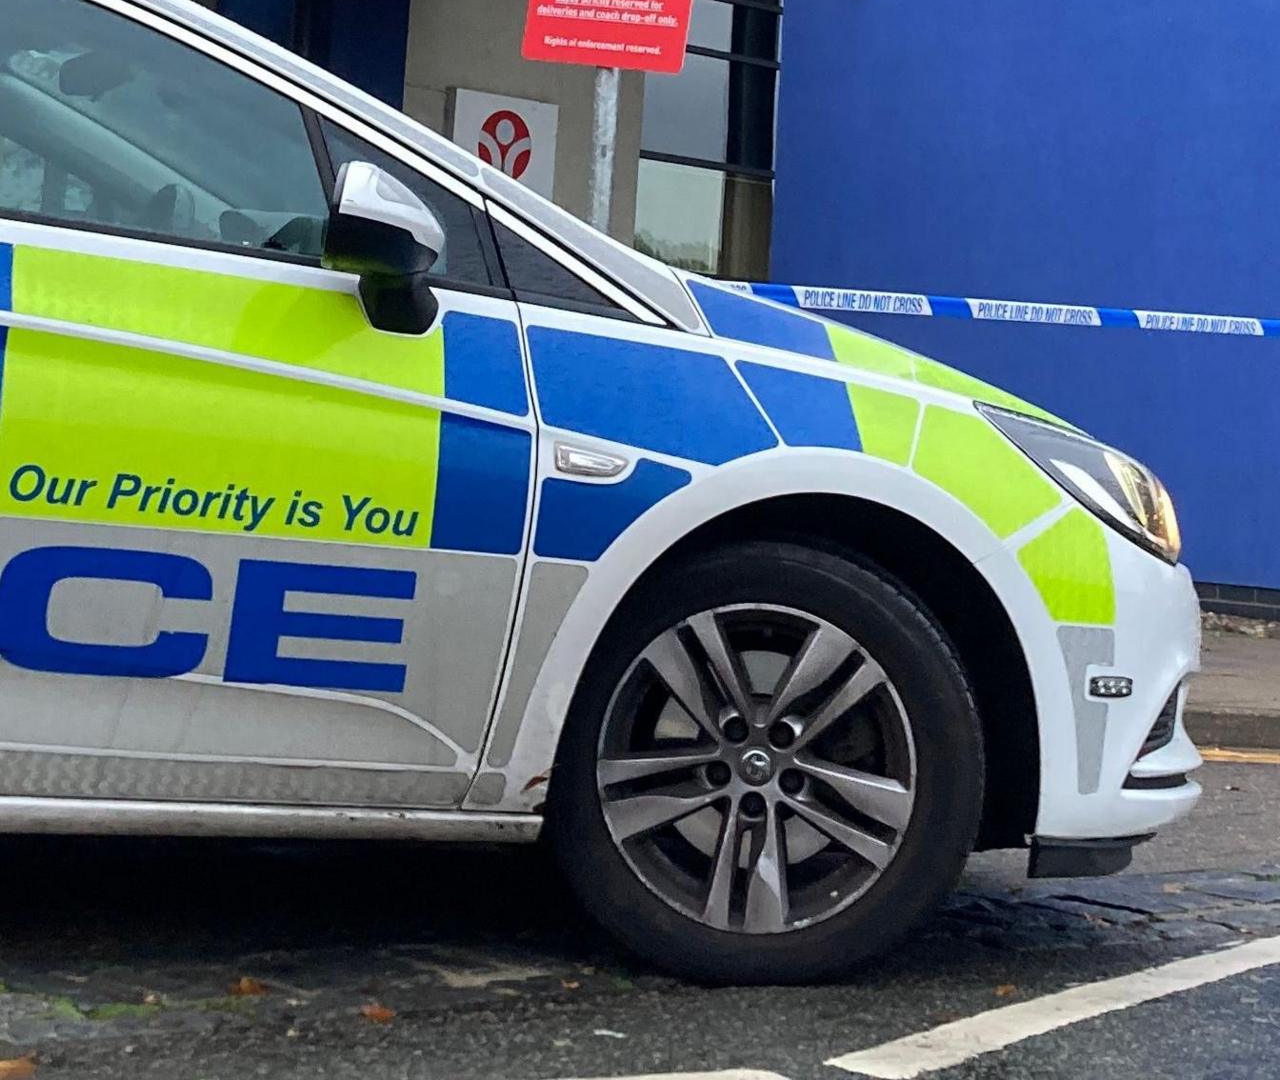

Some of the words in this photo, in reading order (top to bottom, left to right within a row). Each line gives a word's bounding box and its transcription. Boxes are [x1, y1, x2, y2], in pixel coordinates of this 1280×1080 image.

[537, 4, 578, 18] deliveries
[579, 8, 595, 19] and
[596, 9, 620, 21] coach
[621, 11, 657, 24] drop-off
[650, 0, 664, 10] for
[544, 35, 568, 48] Rights
[568, 38, 576, 47] of
[577, 39, 625, 51] enforcement
[626, 43, 661, 56] reserved.
[804, 289, 835, 307] POLICE
[837, 291, 857, 309] LINE
[858, 293, 872, 310] DO
[873, 294, 892, 311] NOT
[893, 295, 924, 313] CROSS
[977, 302, 1008, 319] POLICE
[1009, 304, 1029, 321] LINE
[1030, 305, 1044, 321] DO
[1045, 306, 1063, 323] NOT
[1064, 308, 1094, 324] CROSS
[9, 464, 97, 506] Our
[107, 473, 276, 531] Priority
[285, 490, 324, 528] is
[341, 494, 419, 537] You
